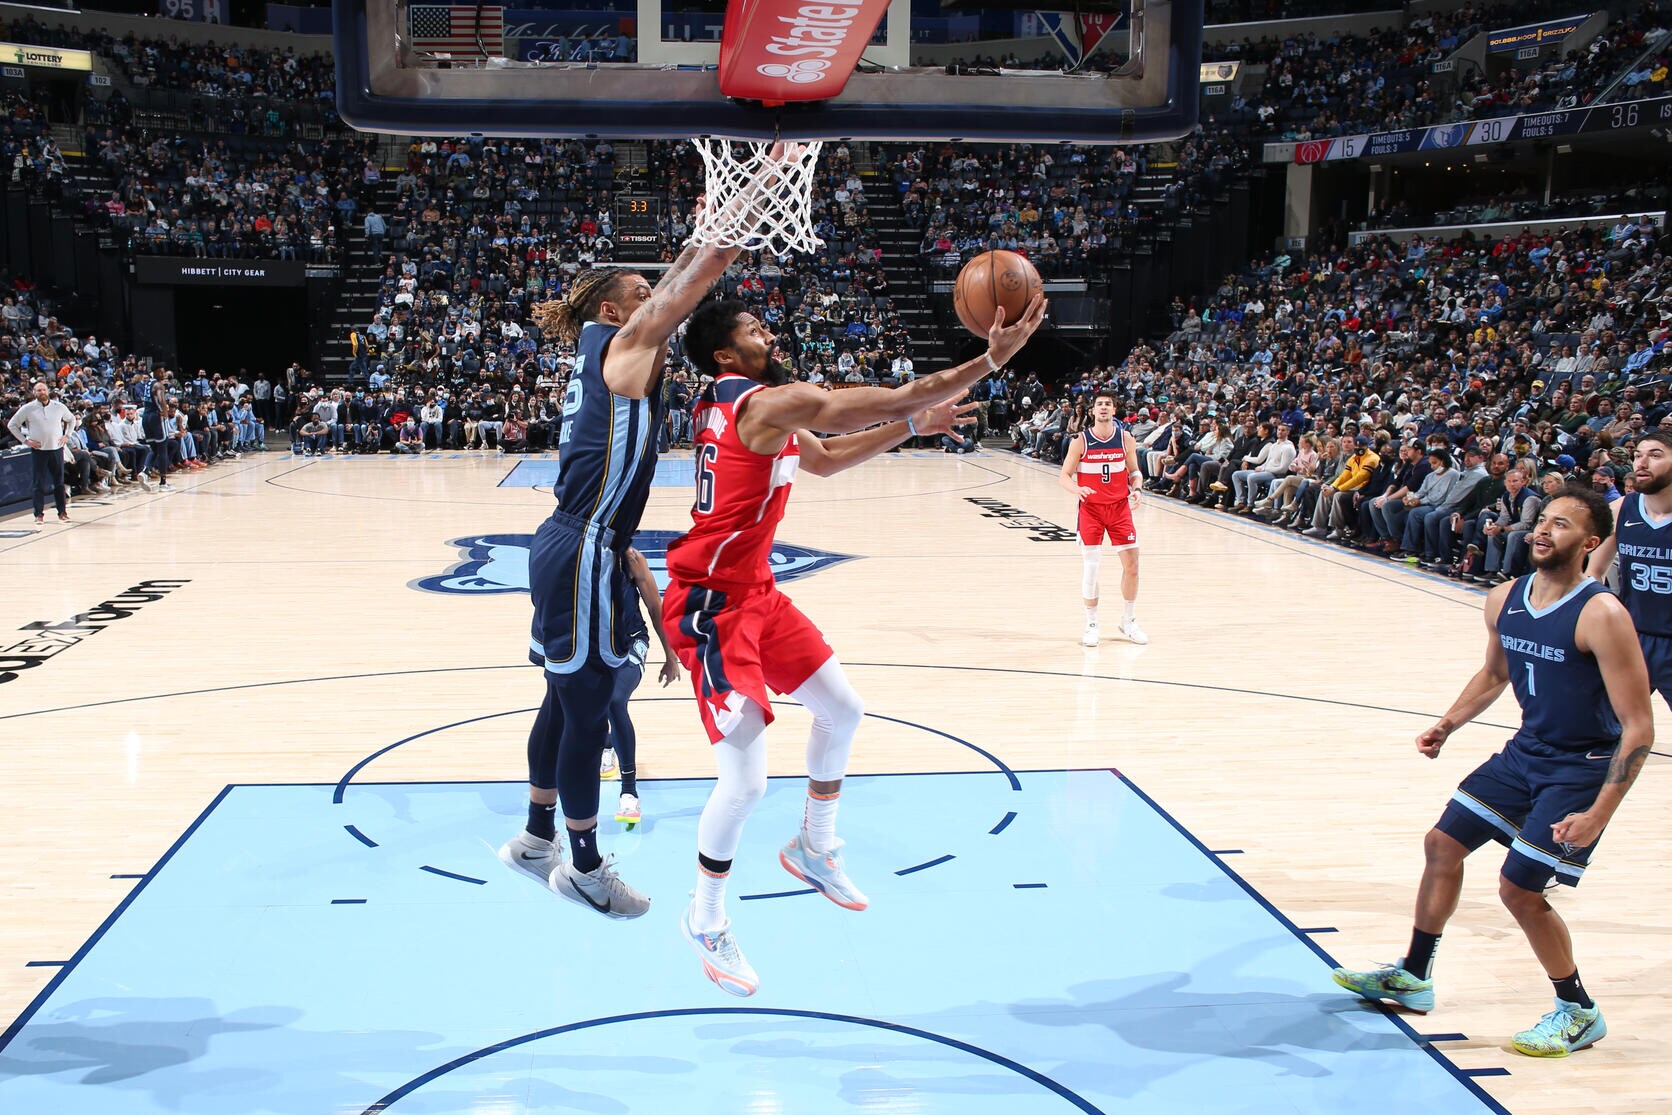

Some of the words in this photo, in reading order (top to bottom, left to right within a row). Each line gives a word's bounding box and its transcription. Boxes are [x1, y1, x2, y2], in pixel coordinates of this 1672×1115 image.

[26, 53, 62, 63] LOTTERY
[1519, 50, 1537, 58] 116A
[1524, 116, 1563, 127] TIMEOUTS:
[1564, 113, 1569, 122] 7
[1612, 104, 1639, 128] 3.6
[1481, 121, 1501, 142] 30
[1522, 127, 1547, 138] FOULS:
[1548, 126, 1553, 135] 5
[1372, 135, 1405, 144] TIMEOUTS:
[1341, 138, 1354, 157] 15
[1371, 145, 1392, 155] FOULS:
[631, 200, 647, 212] 3.3
[181, 267, 216, 275] HIBBETT
[1087, 452, 1124, 461] washington
[696, 443, 718, 515] 6
[1102, 463, 1111, 484] 9
[1630, 562, 1672, 595] 35
[1500, 634, 1565, 663] GRIZZLIES
[1525, 661, 1536, 697] 1
